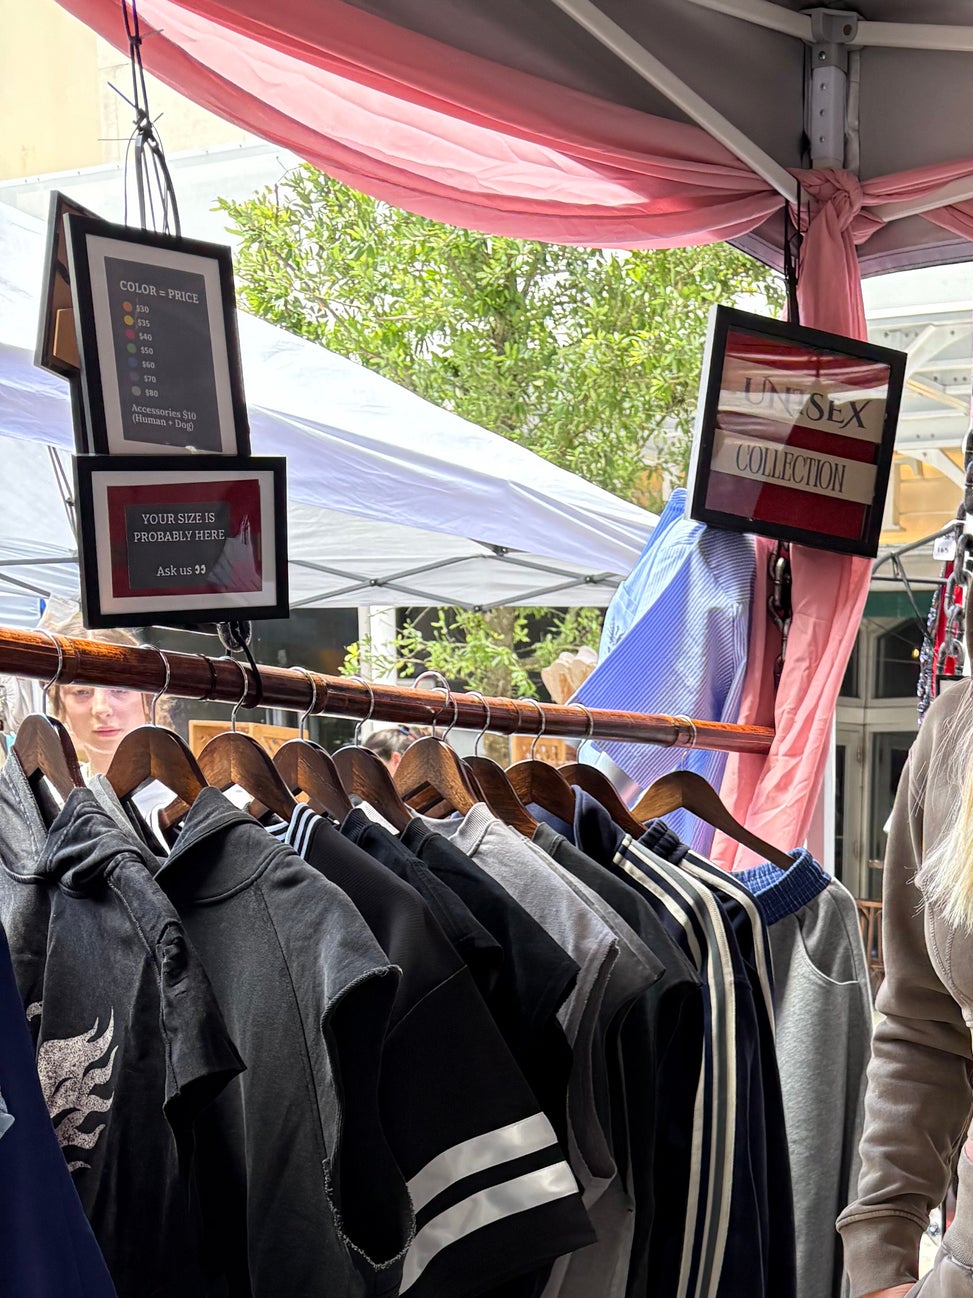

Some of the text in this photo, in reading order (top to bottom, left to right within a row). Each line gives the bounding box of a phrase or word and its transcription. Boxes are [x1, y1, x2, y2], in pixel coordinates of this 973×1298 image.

[120, 280, 157, 296] COLOR
[168, 288, 199, 304] PRICE
[136, 305, 149, 313] $30
[138, 319, 150, 327] $35
[139, 333, 152, 341] $40
[141, 346, 154, 354] $50
[144, 375, 156, 383] $70
[132, 404, 196, 420] Accessories $10
[132, 413, 166, 426] (Human
[175, 420, 194, 431] Dog)
[736, 444, 846, 493] COLLECTION
[142, 512, 215, 524] YOUR SIZE IS
[134, 530, 225, 542] PROBABLY HERE
[157, 565, 192, 577] Ask us
